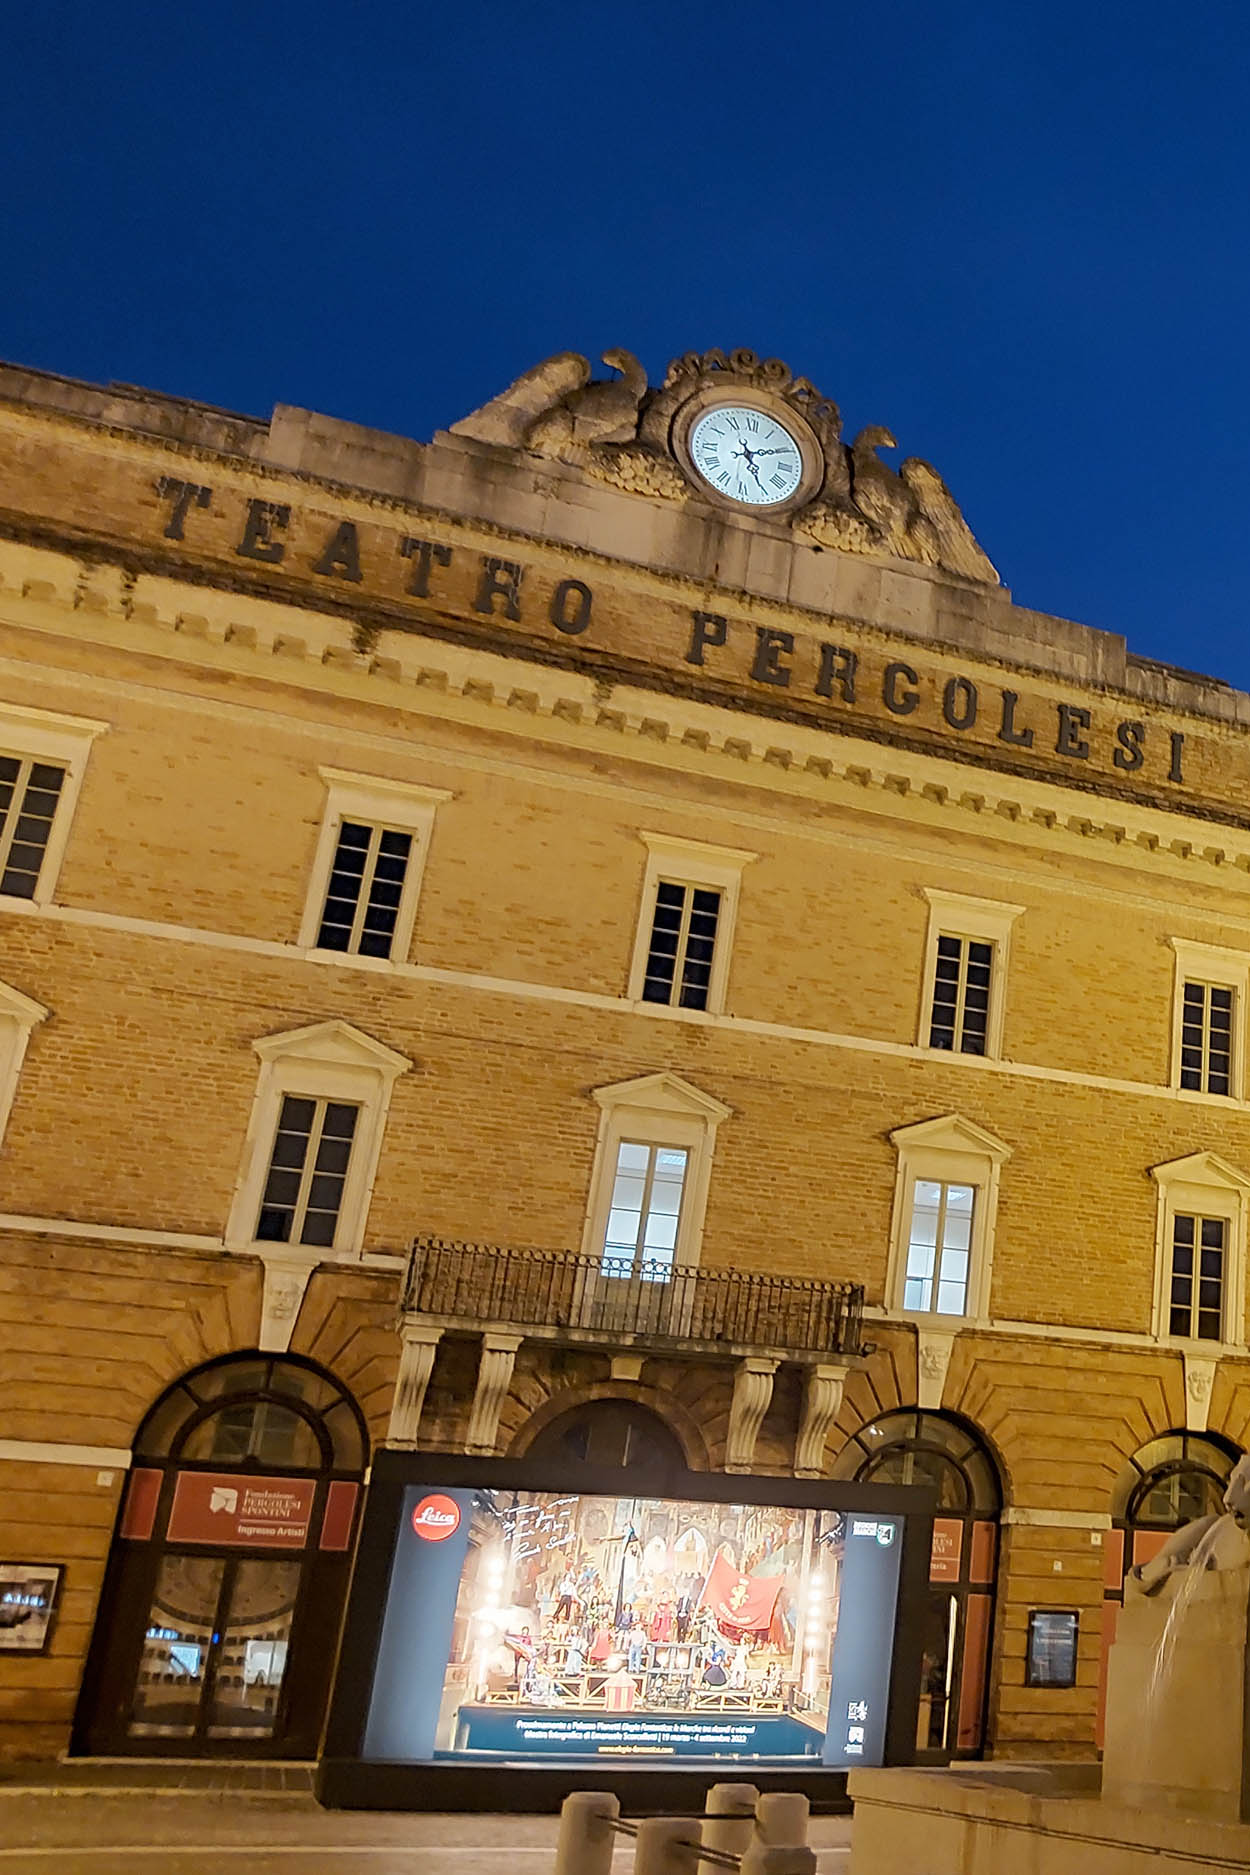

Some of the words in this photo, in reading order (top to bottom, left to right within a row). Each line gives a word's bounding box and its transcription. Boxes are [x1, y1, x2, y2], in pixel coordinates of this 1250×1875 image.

[726, 417, 740, 431] XI
[746, 418, 760, 433] XII
[705, 456, 720, 470] VIII
[777, 462, 792, 472] III
[717, 471, 731, 486] VII
[157, 476, 593, 636] TEATRO
[684, 609, 1185, 784] PERGOLESI
[246, 1489, 296, 1499] Fondazione
[244, 1498, 301, 1510] PERGOLESI
[242, 1506, 290, 1518] SPONTINI
[416, 1506, 456, 1526] Leica
[238, 1525, 276, 1536] Ingresso
[277, 1527, 305, 1536] Artisti
